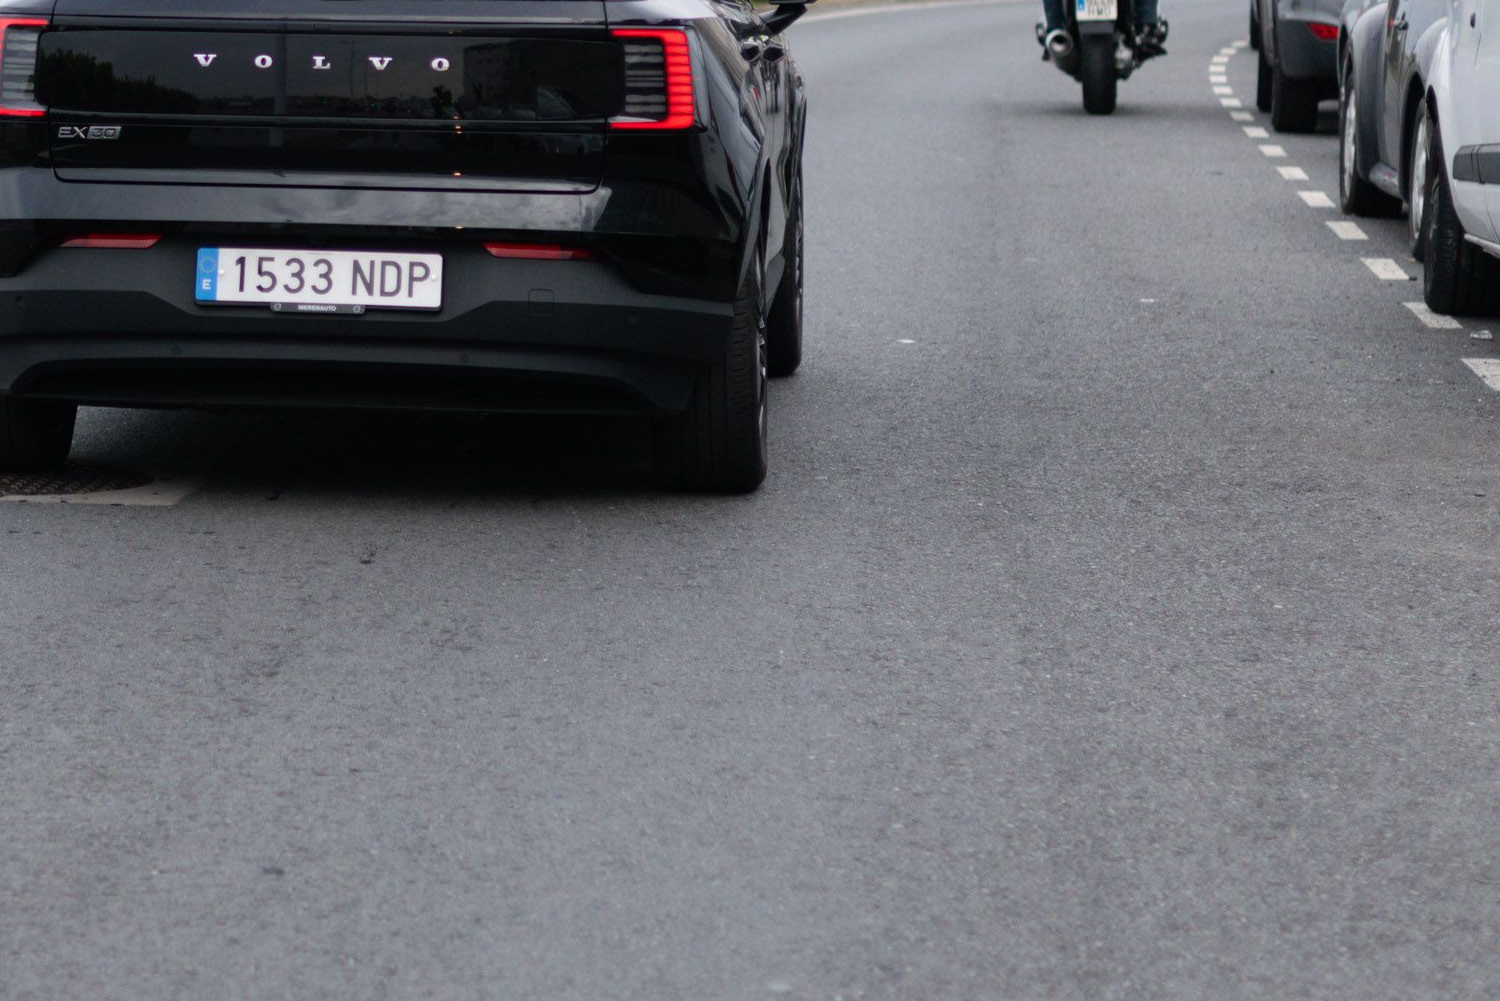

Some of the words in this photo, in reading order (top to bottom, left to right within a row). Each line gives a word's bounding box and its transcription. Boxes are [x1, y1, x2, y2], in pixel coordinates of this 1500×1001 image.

[194, 53, 450, 72] VOLVO
[58, 126, 121, 140] EX30
[202, 279, 212, 290] E
[234, 256, 333, 295] 1533
[351, 259, 431, 298] NDP
